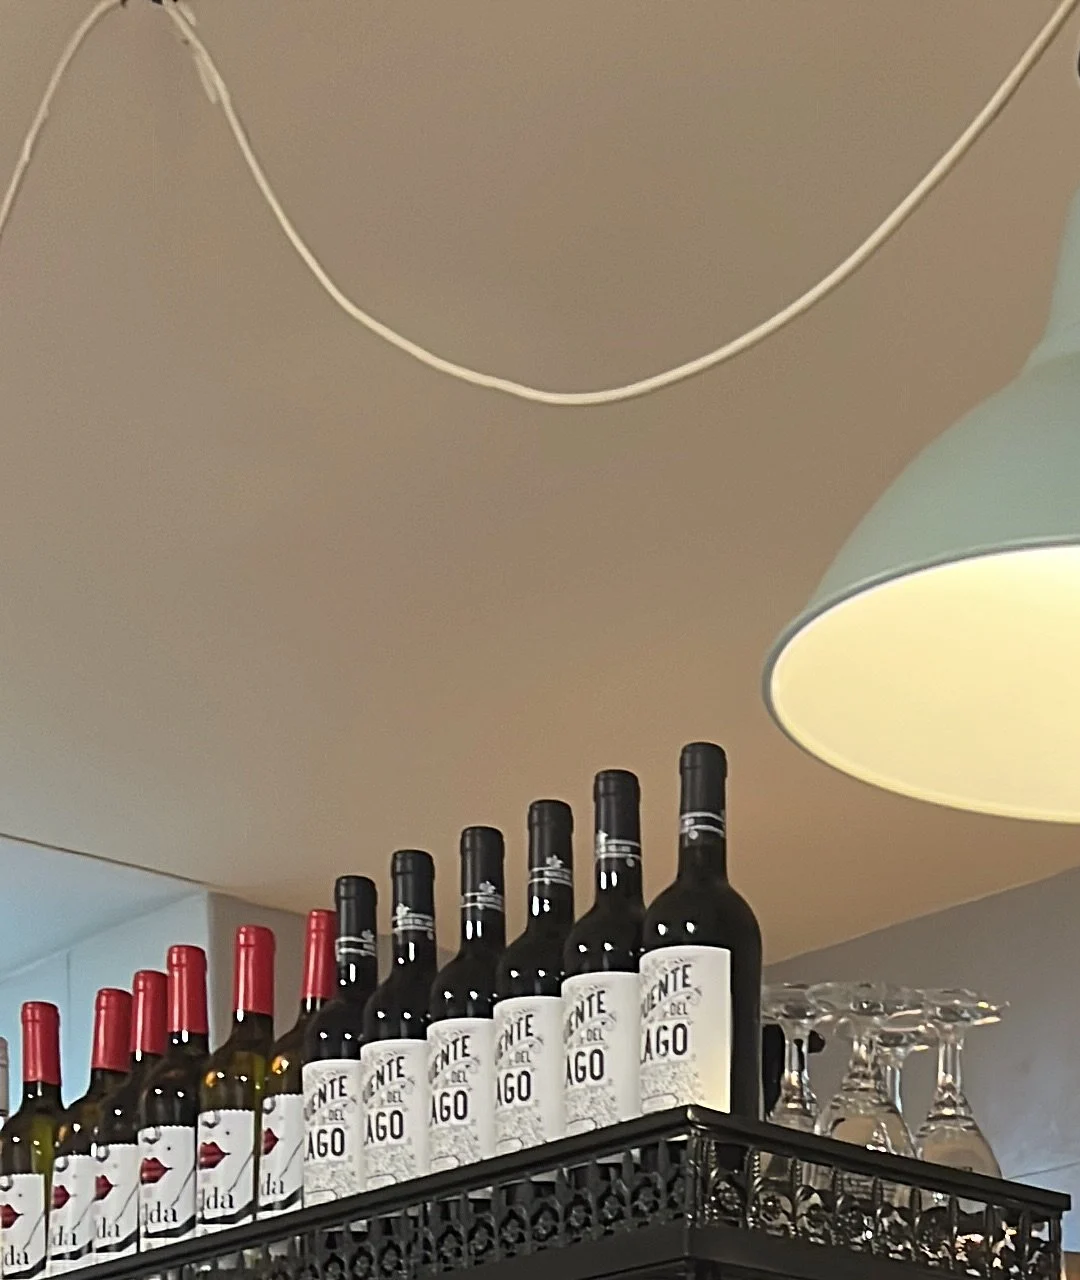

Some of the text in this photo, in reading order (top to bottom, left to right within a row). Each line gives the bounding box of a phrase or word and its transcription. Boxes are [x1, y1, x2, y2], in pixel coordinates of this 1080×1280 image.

[669, 1002, 687, 1017] DEL
[586, 1027, 604, 1041] DEL
[514, 1050, 532, 1064] DEL
